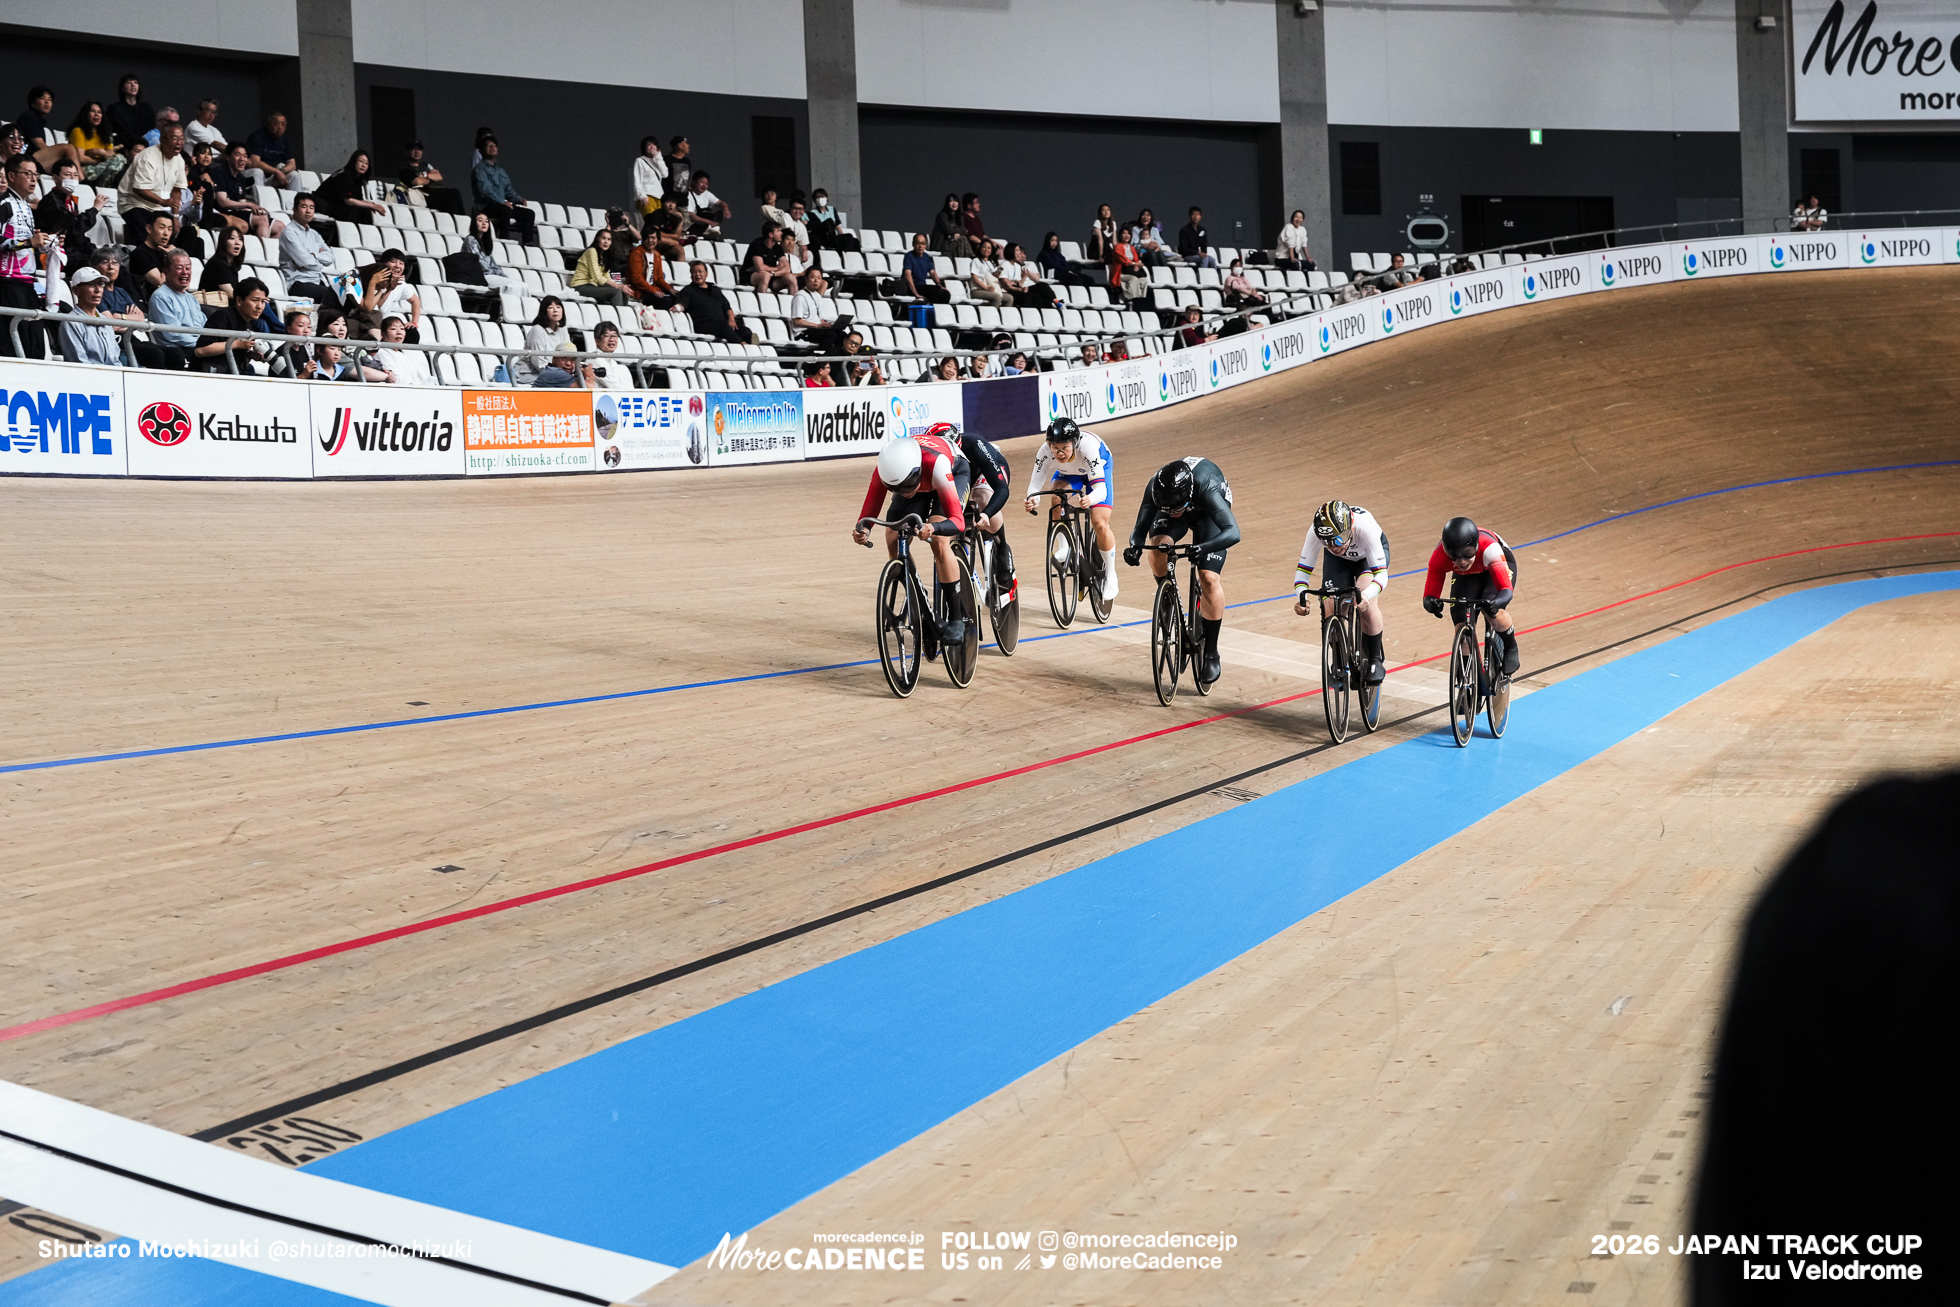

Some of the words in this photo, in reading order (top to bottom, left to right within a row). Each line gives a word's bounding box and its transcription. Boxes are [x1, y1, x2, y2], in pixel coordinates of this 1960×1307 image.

[1802, 0, 1946, 76] More
[1900, 92, 1960, 110] mor
[1702, 247, 1748, 269] NIPPO
[1789, 241, 1836, 263] NIPPO
[1880, 239, 1930, 258] NIPPO
[1539, 266, 1580, 291] NIPPO
[1618, 256, 1662, 280] NIPPO
[1464, 280, 1504, 306] NIPPO
[1395, 296, 1432, 323] NIPPO
[1332, 313, 1365, 341] NIPPO
[1274, 332, 1304, 361] NIPPO
[1220, 348, 1248, 378] NIPPO
[1117, 381, 1147, 410] NIPPO
[1169, 368, 1197, 398] NIPPO
[467, 395, 518, 411] 一般社団法人
[618, 395, 683, 428] 伊豆の国市
[726, 402, 772, 434] Welcome
[772, 403, 783, 433] to
[783, 401, 798, 433] Ito
[1061, 391, 1092, 420] NIPPO
[198, 412, 297, 444] Kabuto
[354, 408, 453, 452] vittoria
[466, 413, 592, 446] 静岡県自転車競技連盟
[806, 400, 886, 445] wattbike
[227, 1117, 364, 1166] 250
[8, 1212, 102, 1243] 0
